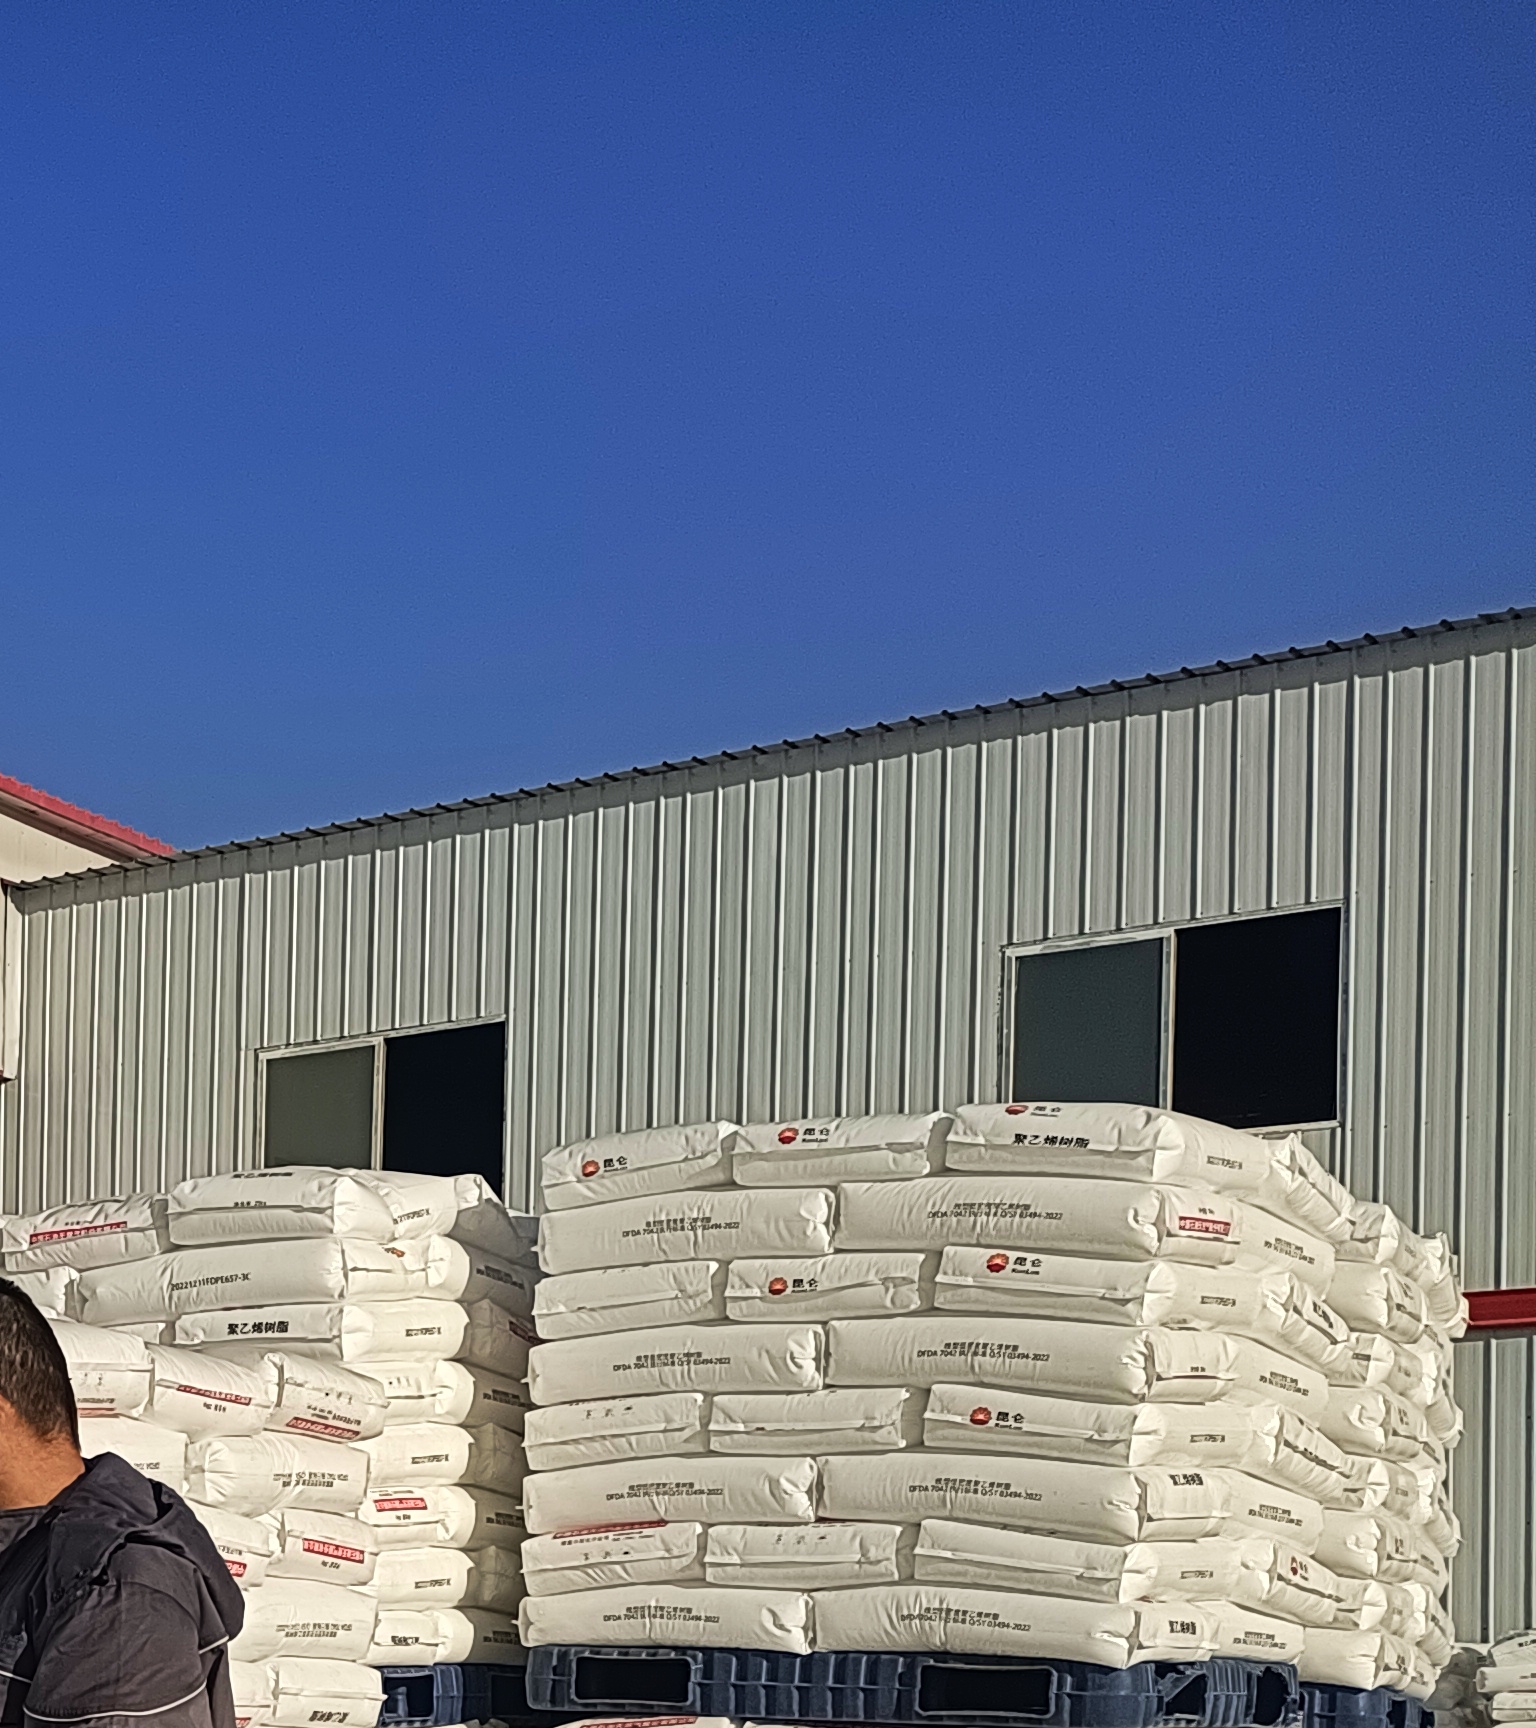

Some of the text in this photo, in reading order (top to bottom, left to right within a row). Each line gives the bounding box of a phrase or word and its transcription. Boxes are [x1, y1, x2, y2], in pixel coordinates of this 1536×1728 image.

[803, 1127, 828, 1136] 昆仑
[1014, 1133, 1090, 1149] 聚乙烯树脂
[603, 1156, 627, 1168] 昆仑
[1019, 1211, 1063, 1220] 03494-2022
[1013, 1256, 1042, 1267] 昆仑
[792, 1278, 818, 1288] 昆仑
[228, 1320, 289, 1335] 聚乙烯树脂
[1007, 1351, 1050, 1361] 03494-2022
[997, 1411, 1025, 1423] 昆仑
[999, 1490, 1042, 1501] 03494-2022
[987, 1621, 1031, 1631] 03494-2022
